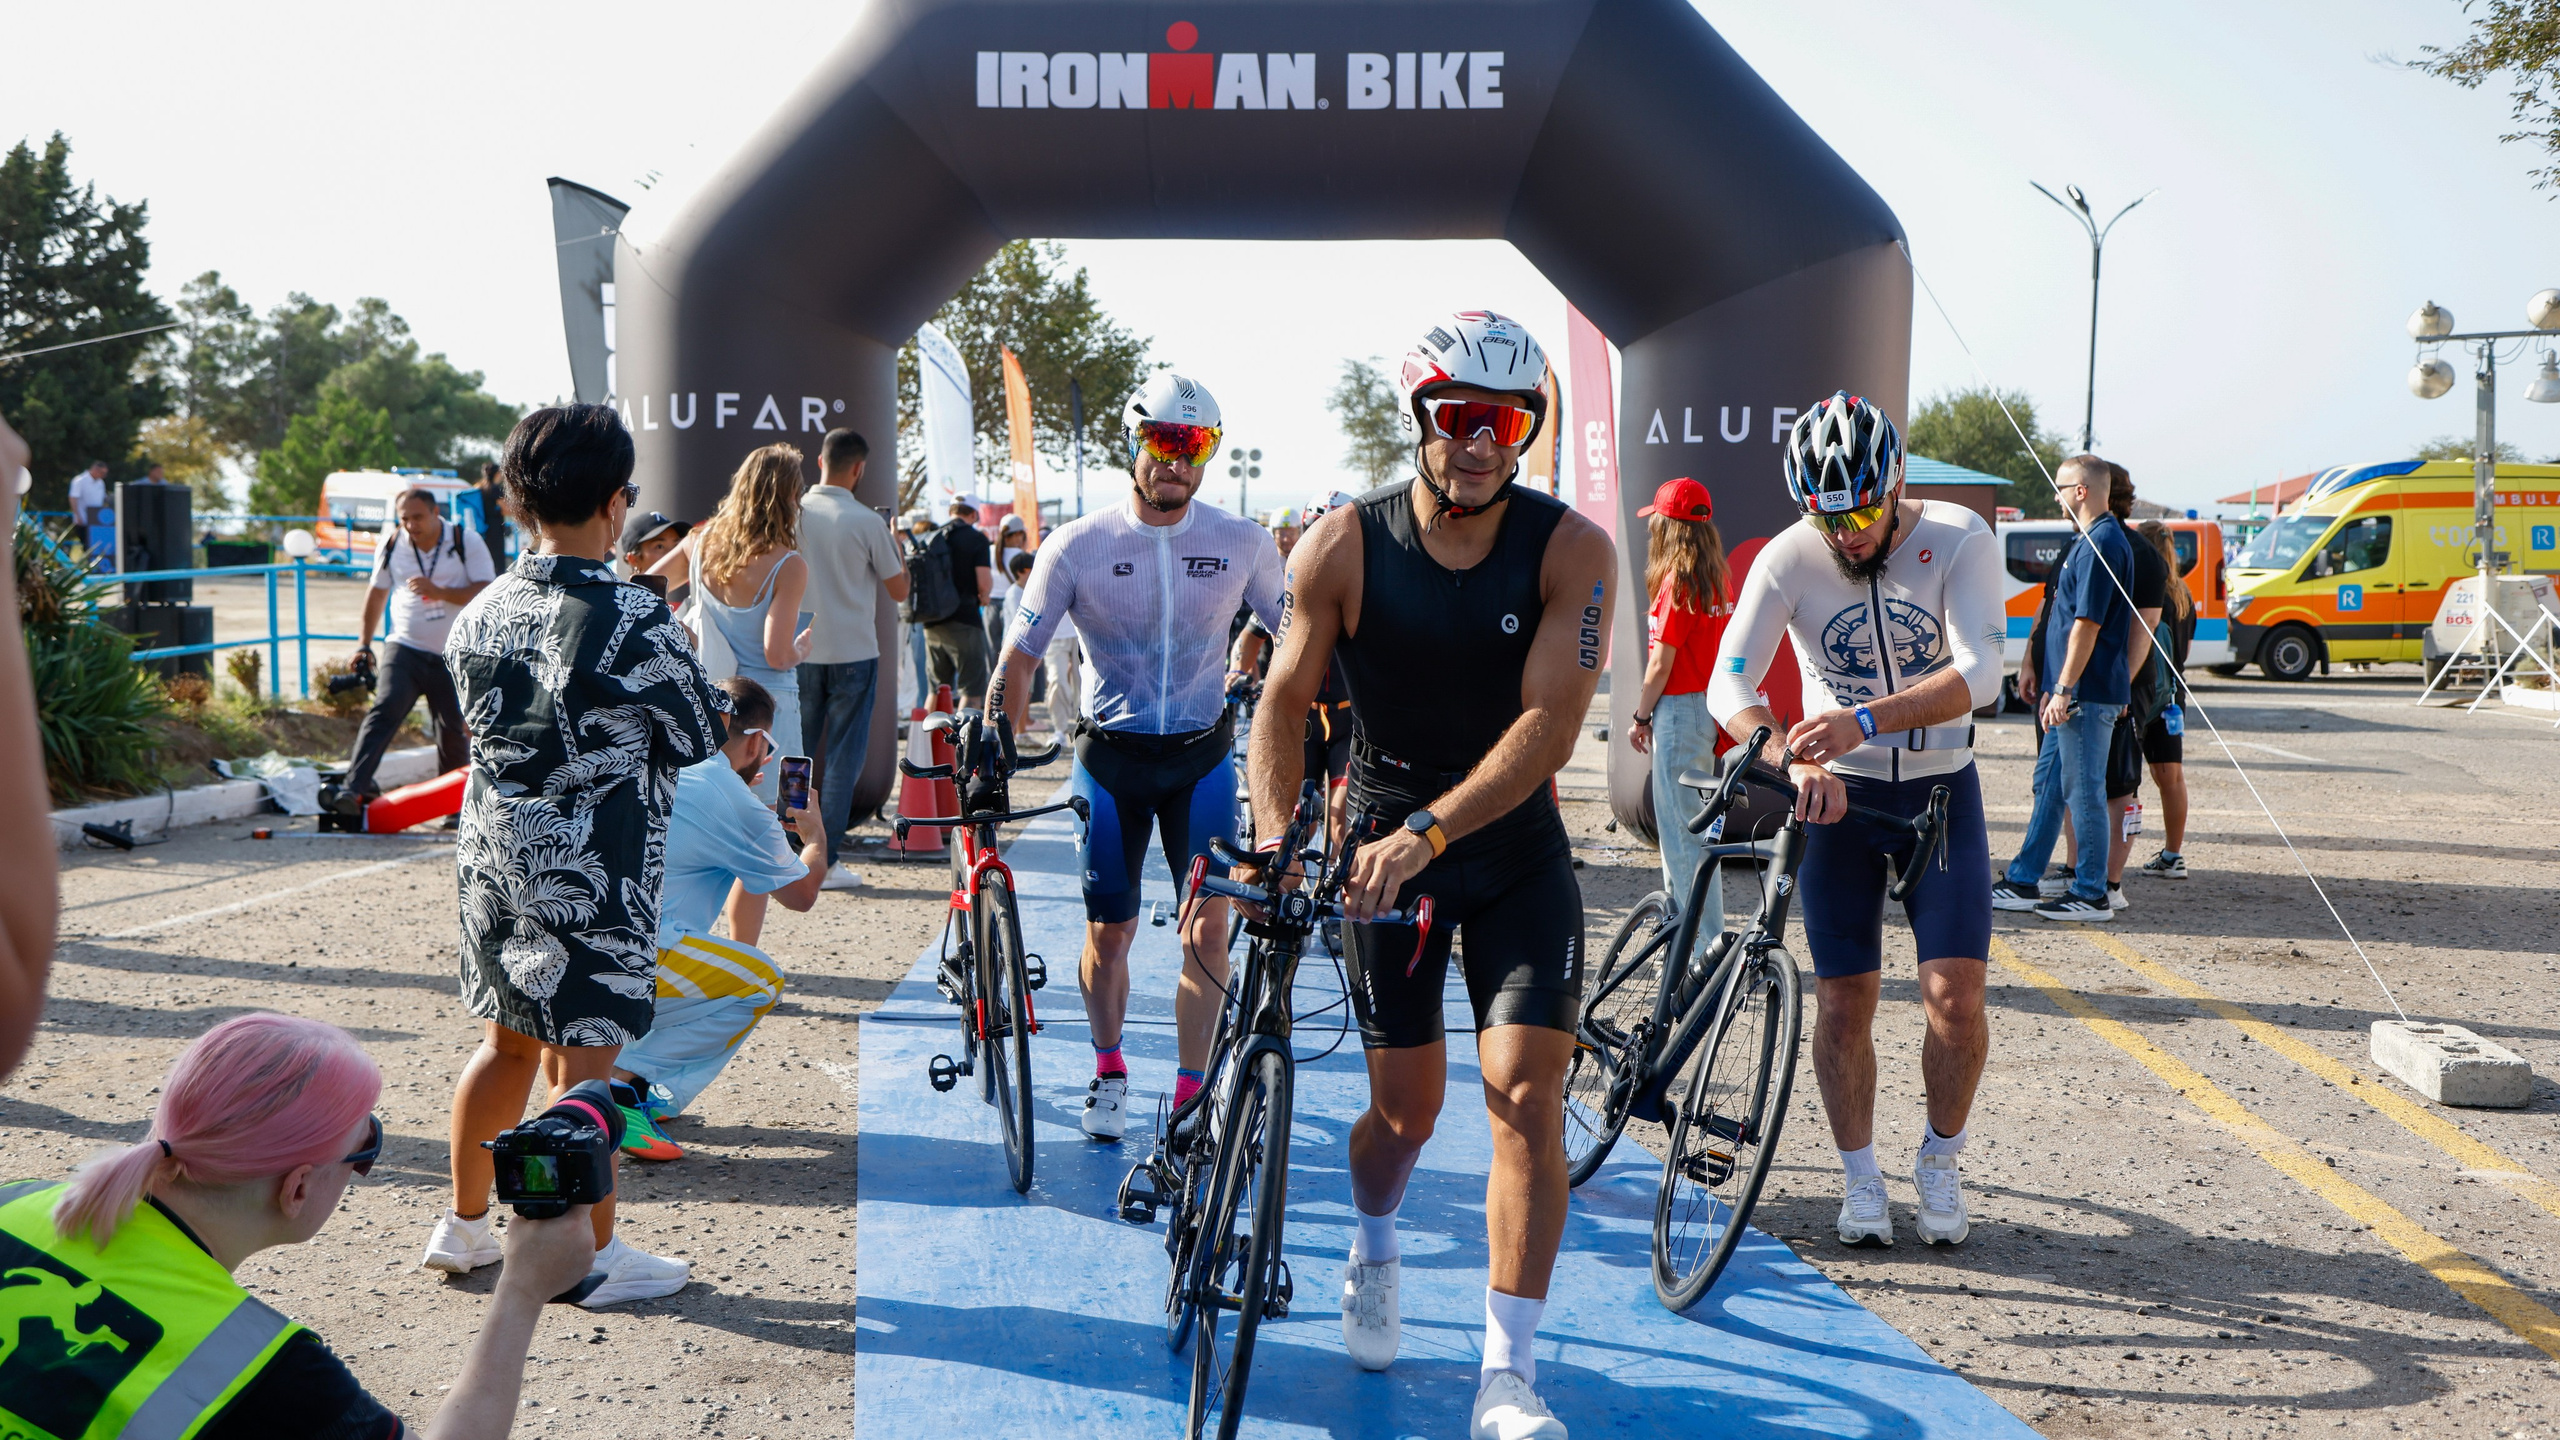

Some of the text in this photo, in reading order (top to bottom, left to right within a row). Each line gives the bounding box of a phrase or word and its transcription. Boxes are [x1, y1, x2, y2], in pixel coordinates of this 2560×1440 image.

[977, 51, 1505, 110] IRONMAN BIKE
[1482, 336, 1516, 347] BBB
[1182, 404, 1197, 413] 596
[1645, 405, 1798, 444] ALUF
[1826, 493, 1845, 503] 550
[2494, 493, 2560, 506] MBUL
[1579, 604, 1603, 671] 955
